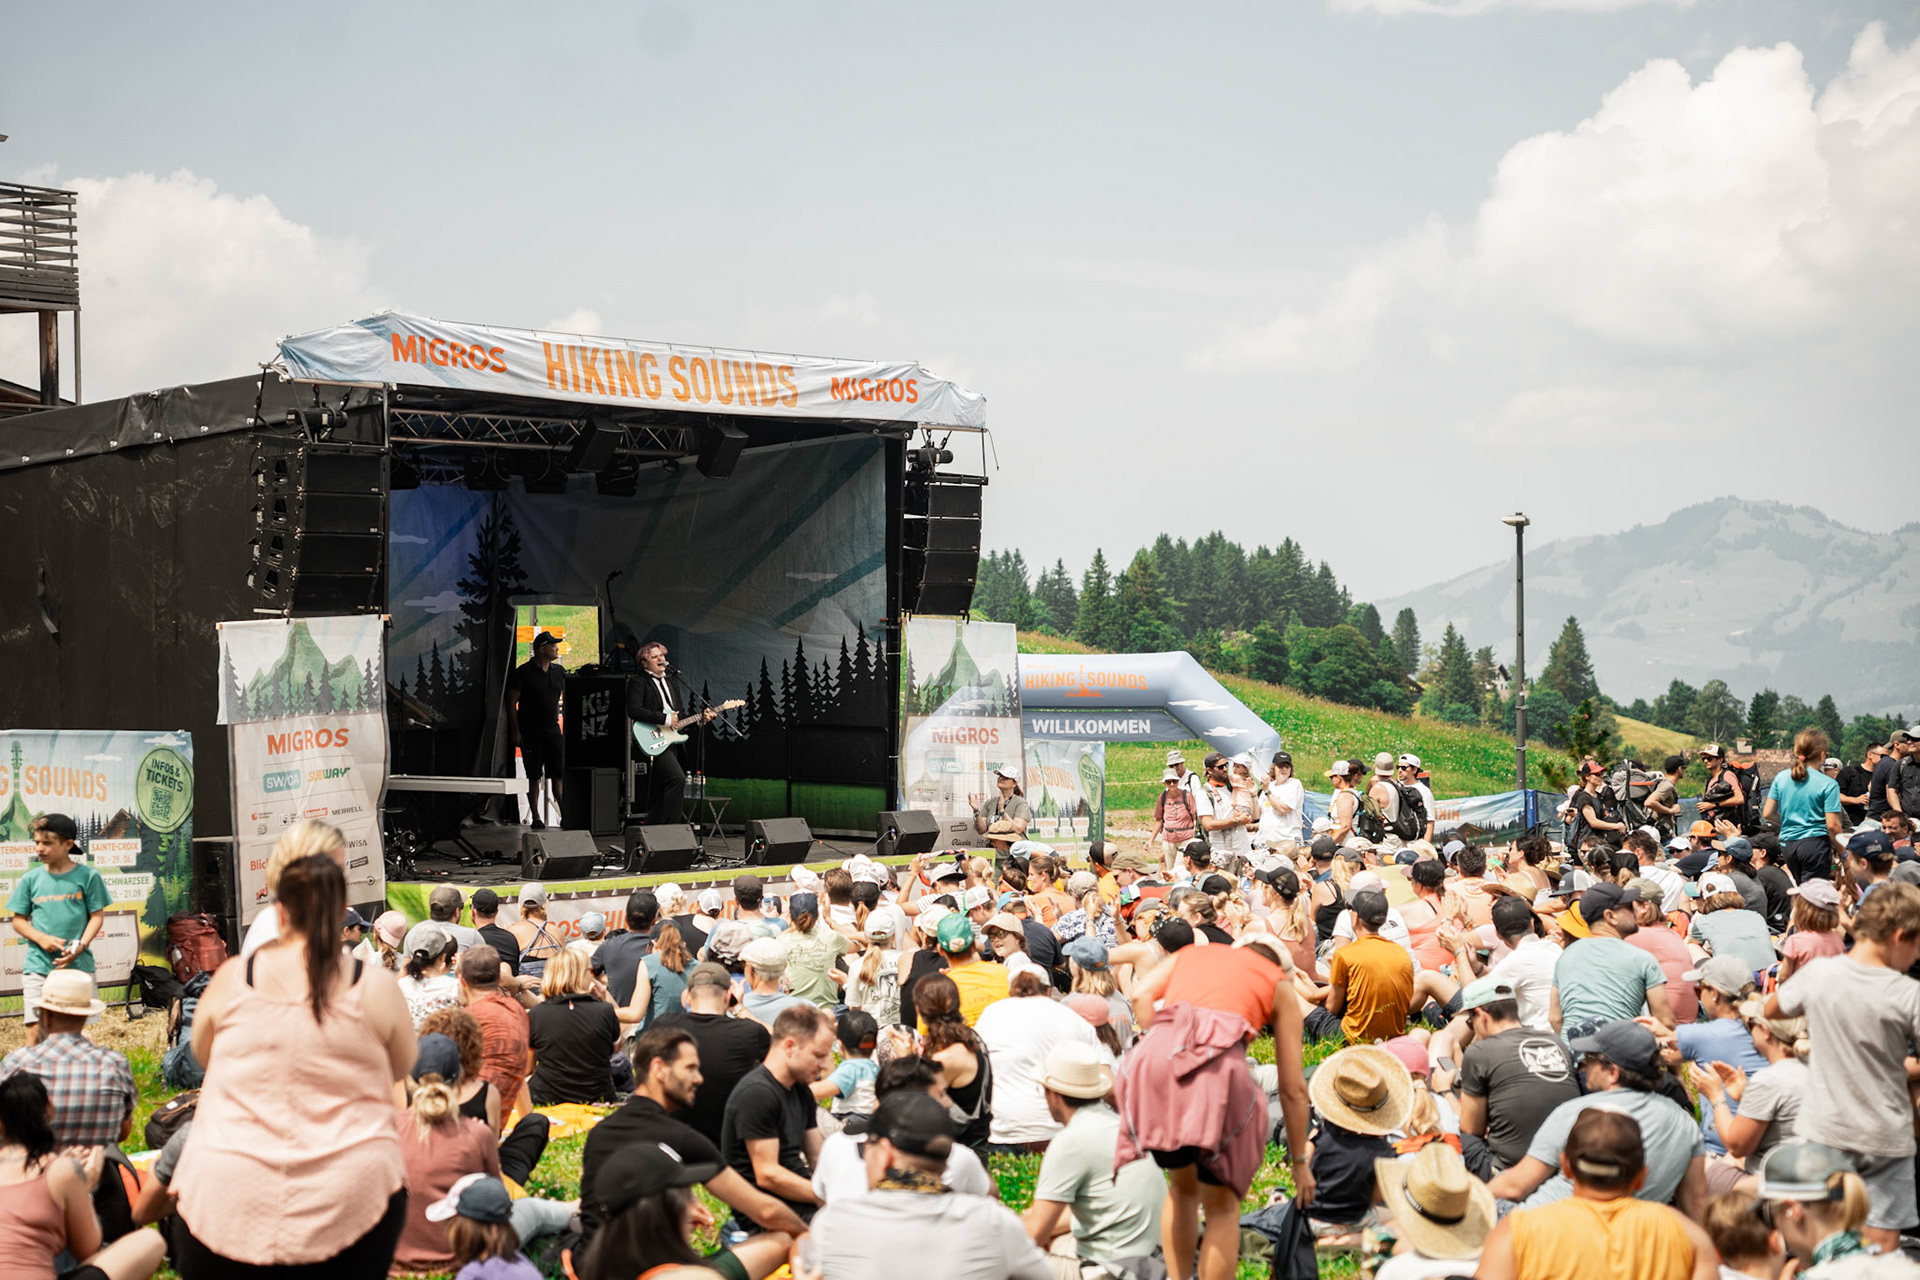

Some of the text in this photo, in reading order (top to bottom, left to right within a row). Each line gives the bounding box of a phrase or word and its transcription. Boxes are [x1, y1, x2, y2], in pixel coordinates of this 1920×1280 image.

[391, 333, 508, 373] MIGROS
[542, 341, 799, 408] HIKING SOUNDS
[830, 376, 919, 404] MIGROS
[1025, 671, 1148, 691] HIKING SOUNDS
[931, 727, 1000, 745] MIGROS
[1031, 718, 1152, 735] WILLKOMMEN
[267, 728, 350, 756] MIGROS
[151, 758, 181, 778] INFOS &
[307, 766, 352, 783] SUBWAY
[25, 765, 107, 803] SOUNDS
[146, 768, 184, 793] TICKETS
[1043, 765, 1076, 792] SOUNDS
[331, 806, 363, 816] MERRELL
[91, 842, 138, 852] SAINTE-CROIX
[104, 876, 150, 887] SCHWARZSEE
